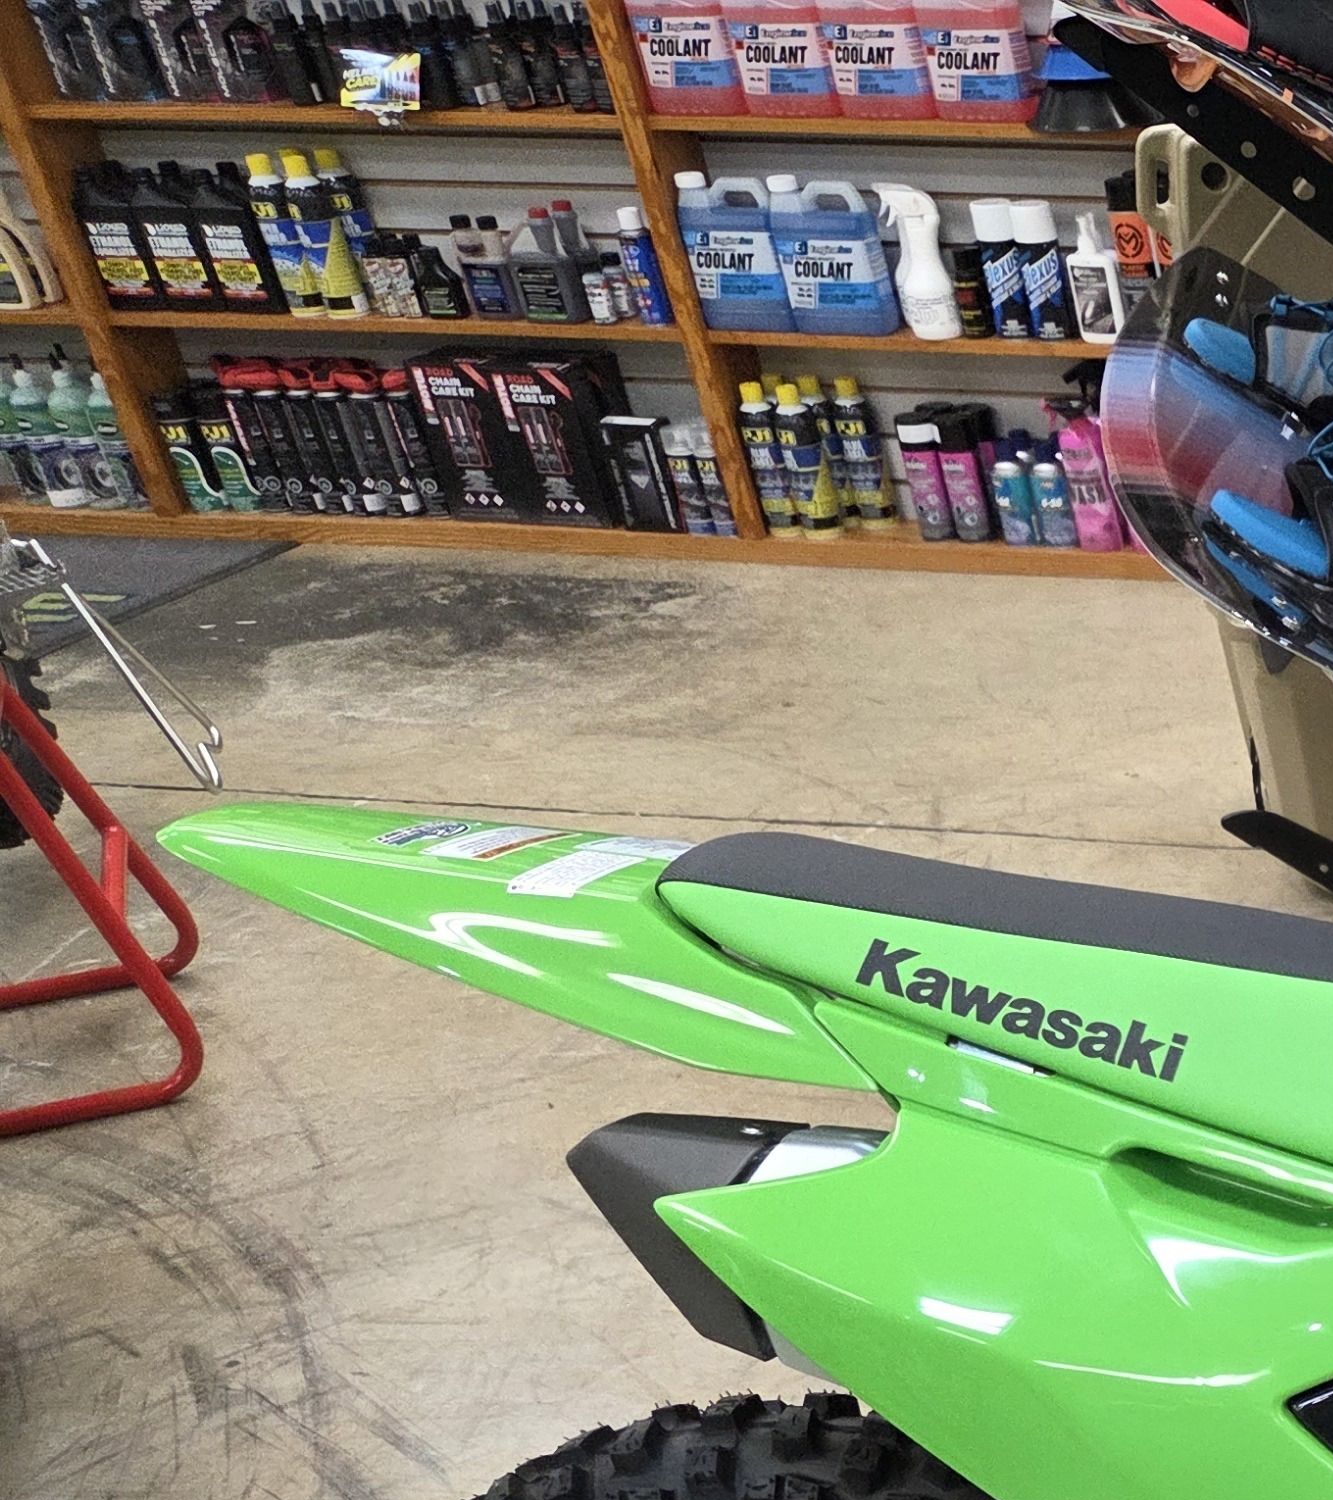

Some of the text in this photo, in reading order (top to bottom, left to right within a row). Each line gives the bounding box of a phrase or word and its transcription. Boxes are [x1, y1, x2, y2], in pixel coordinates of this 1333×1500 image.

[650, 38, 711, 57] COOLANT
[746, 45, 808, 63] COOLANT
[835, 47, 894, 65] COOLANT
[937, 52, 1000, 70] COOLANT
[696, 252, 754, 272] COOLANT
[794, 260, 853, 281] COOLANT
[428, 376, 461, 387] CHAIN
[509, 384, 541, 394] CHAIN
[431, 386, 474, 398] CARE KIT
[512, 393, 556, 405] CARE KIT
[855, 938, 1188, 1083] Kawasaki
